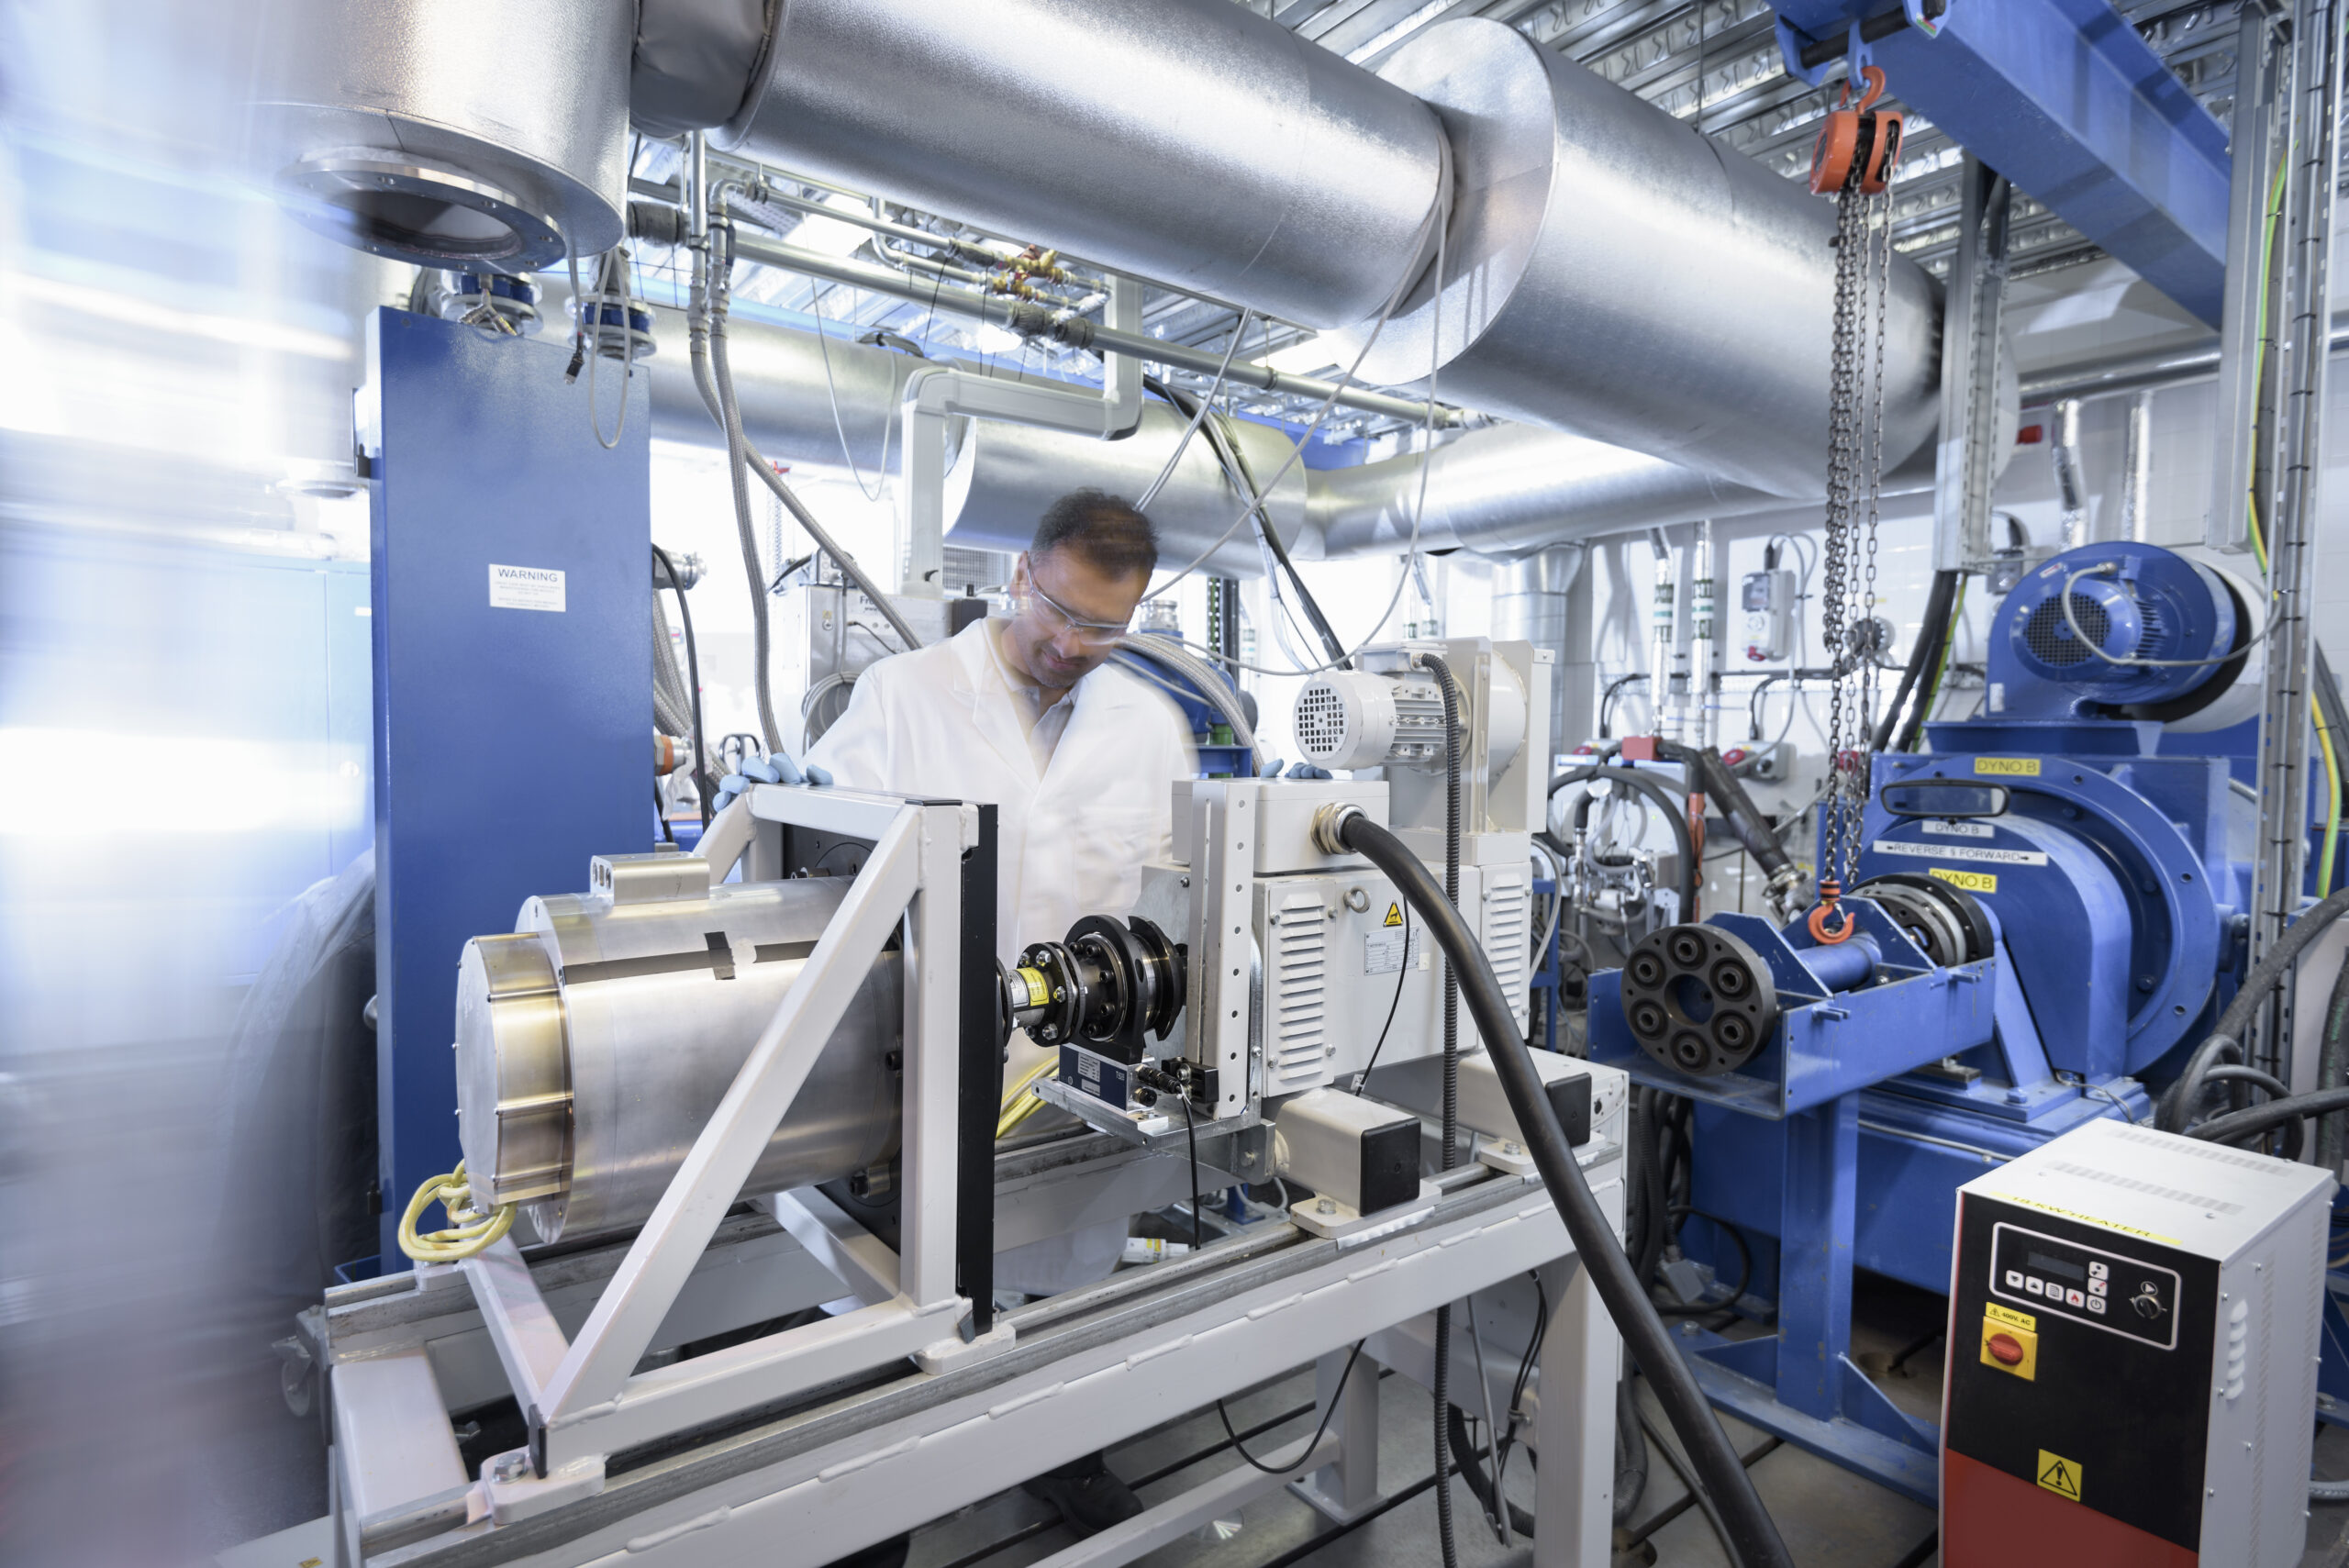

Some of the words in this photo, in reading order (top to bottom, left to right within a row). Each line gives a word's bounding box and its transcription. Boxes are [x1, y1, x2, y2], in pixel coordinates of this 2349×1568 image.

[498, 568, 558, 583] WARNING
[1977, 760, 2021, 773] DYNO
[2026, 761, 2036, 773] B
[1935, 822, 1968, 834] DYNO
[1971, 825, 1979, 834] B
[1894, 843, 1946, 856] REVERSE
[1959, 848, 2020, 862] FORWARD
[1981, 876, 1993, 889] B
[2021, 1318, 2031, 1326] AC
